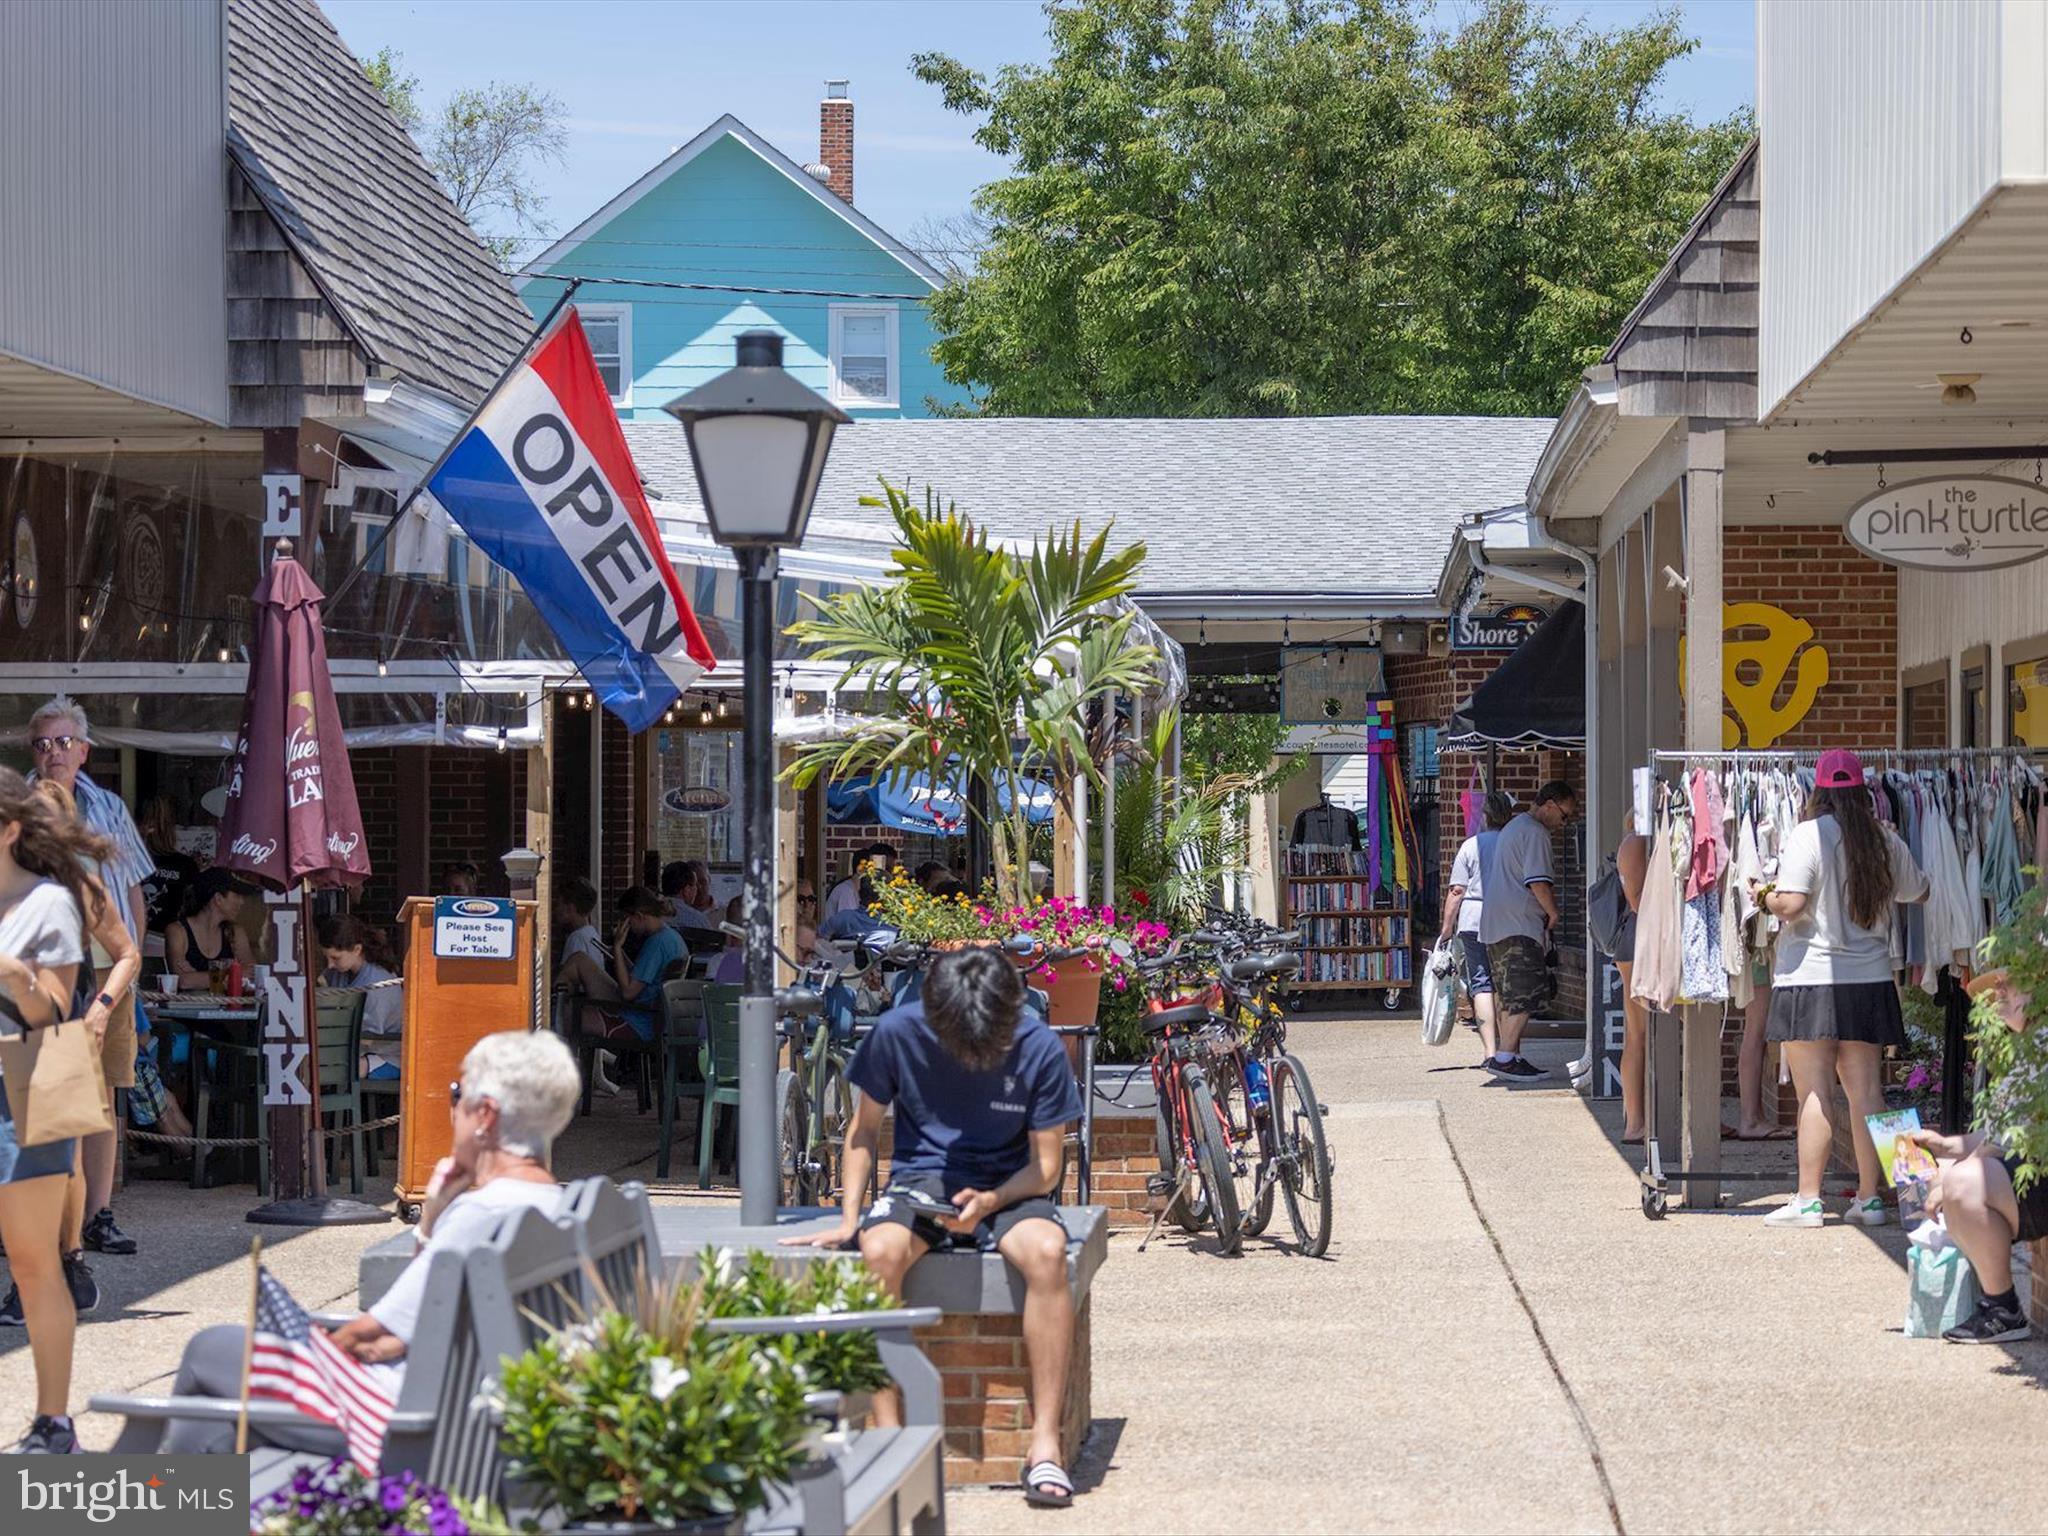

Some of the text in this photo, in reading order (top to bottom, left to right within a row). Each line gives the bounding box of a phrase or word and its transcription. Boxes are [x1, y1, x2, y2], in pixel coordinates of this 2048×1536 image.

[1945, 486, 1977, 503] the
[1868, 498, 2048, 544] pink turtle
[512, 413, 682, 655] OPEN
[1460, 621, 1519, 643] Shore
[446, 922, 505, 932] Please See
[463, 934, 487, 942] Host
[451, 945, 499, 954] For Table
